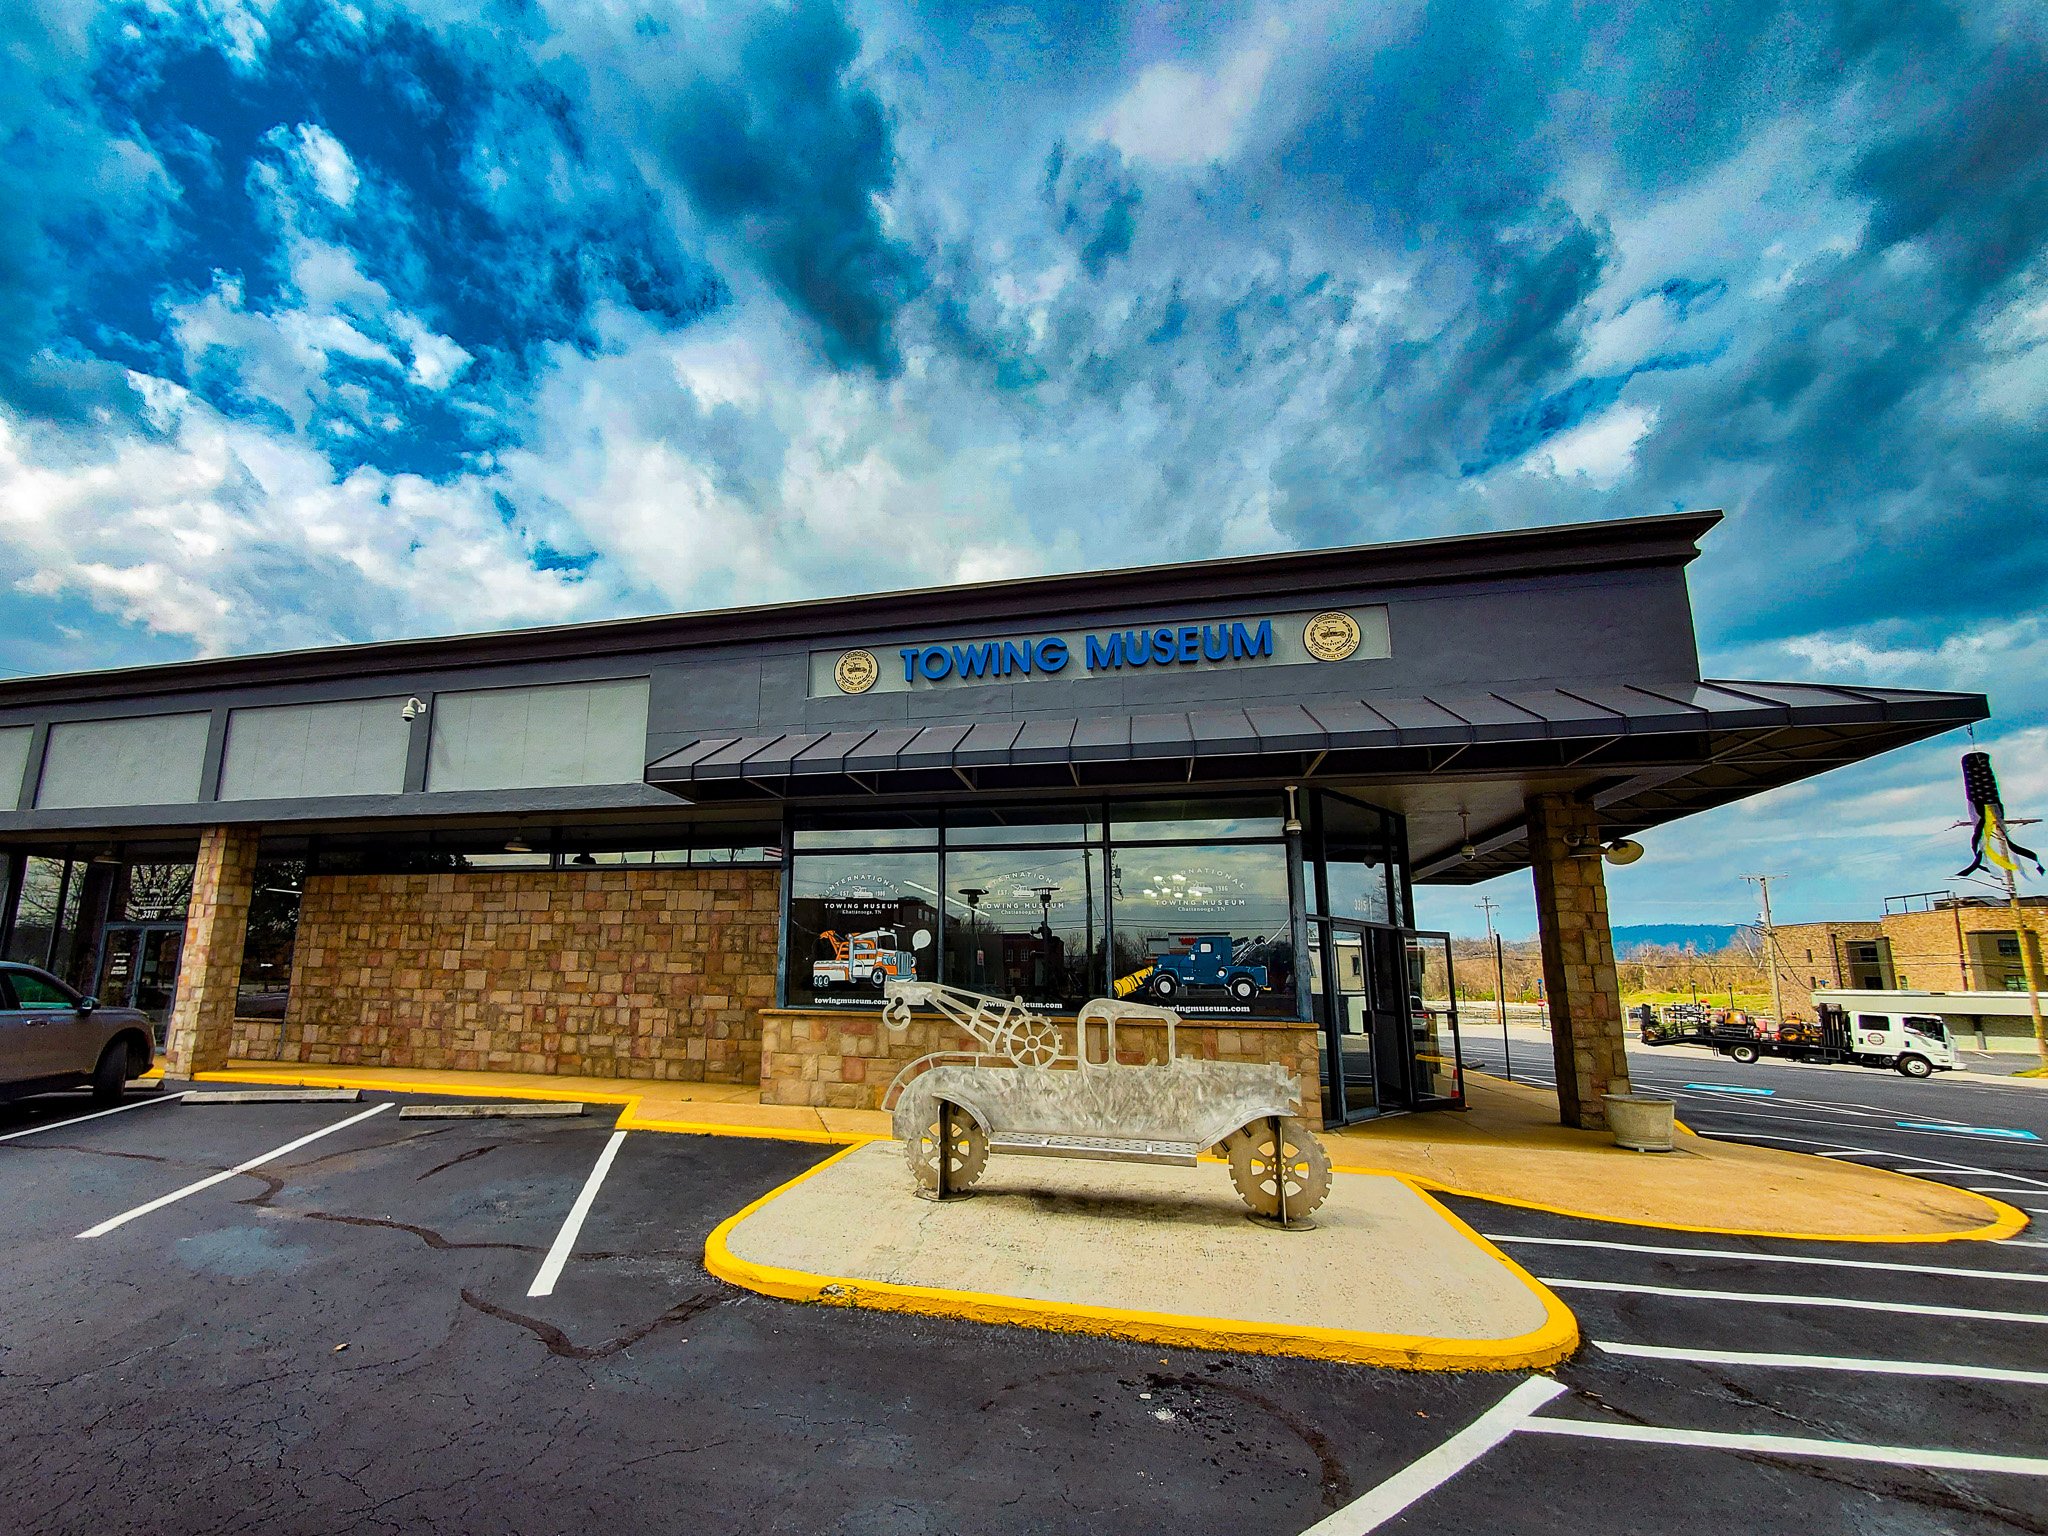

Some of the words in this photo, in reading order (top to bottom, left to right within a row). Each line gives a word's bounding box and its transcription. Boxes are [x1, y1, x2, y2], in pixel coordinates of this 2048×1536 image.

[900, 636, 1070, 683] TOWING
[1085, 619, 1274, 671] MUSEUM
[825, 874, 899, 895] INTERNATIONAL
[981, 871, 1064, 894] INTERNATIONAL
[1155, 867, 1245, 890] INTRNATIONAL
[814, 997, 889, 1005] towingmuseum.com
